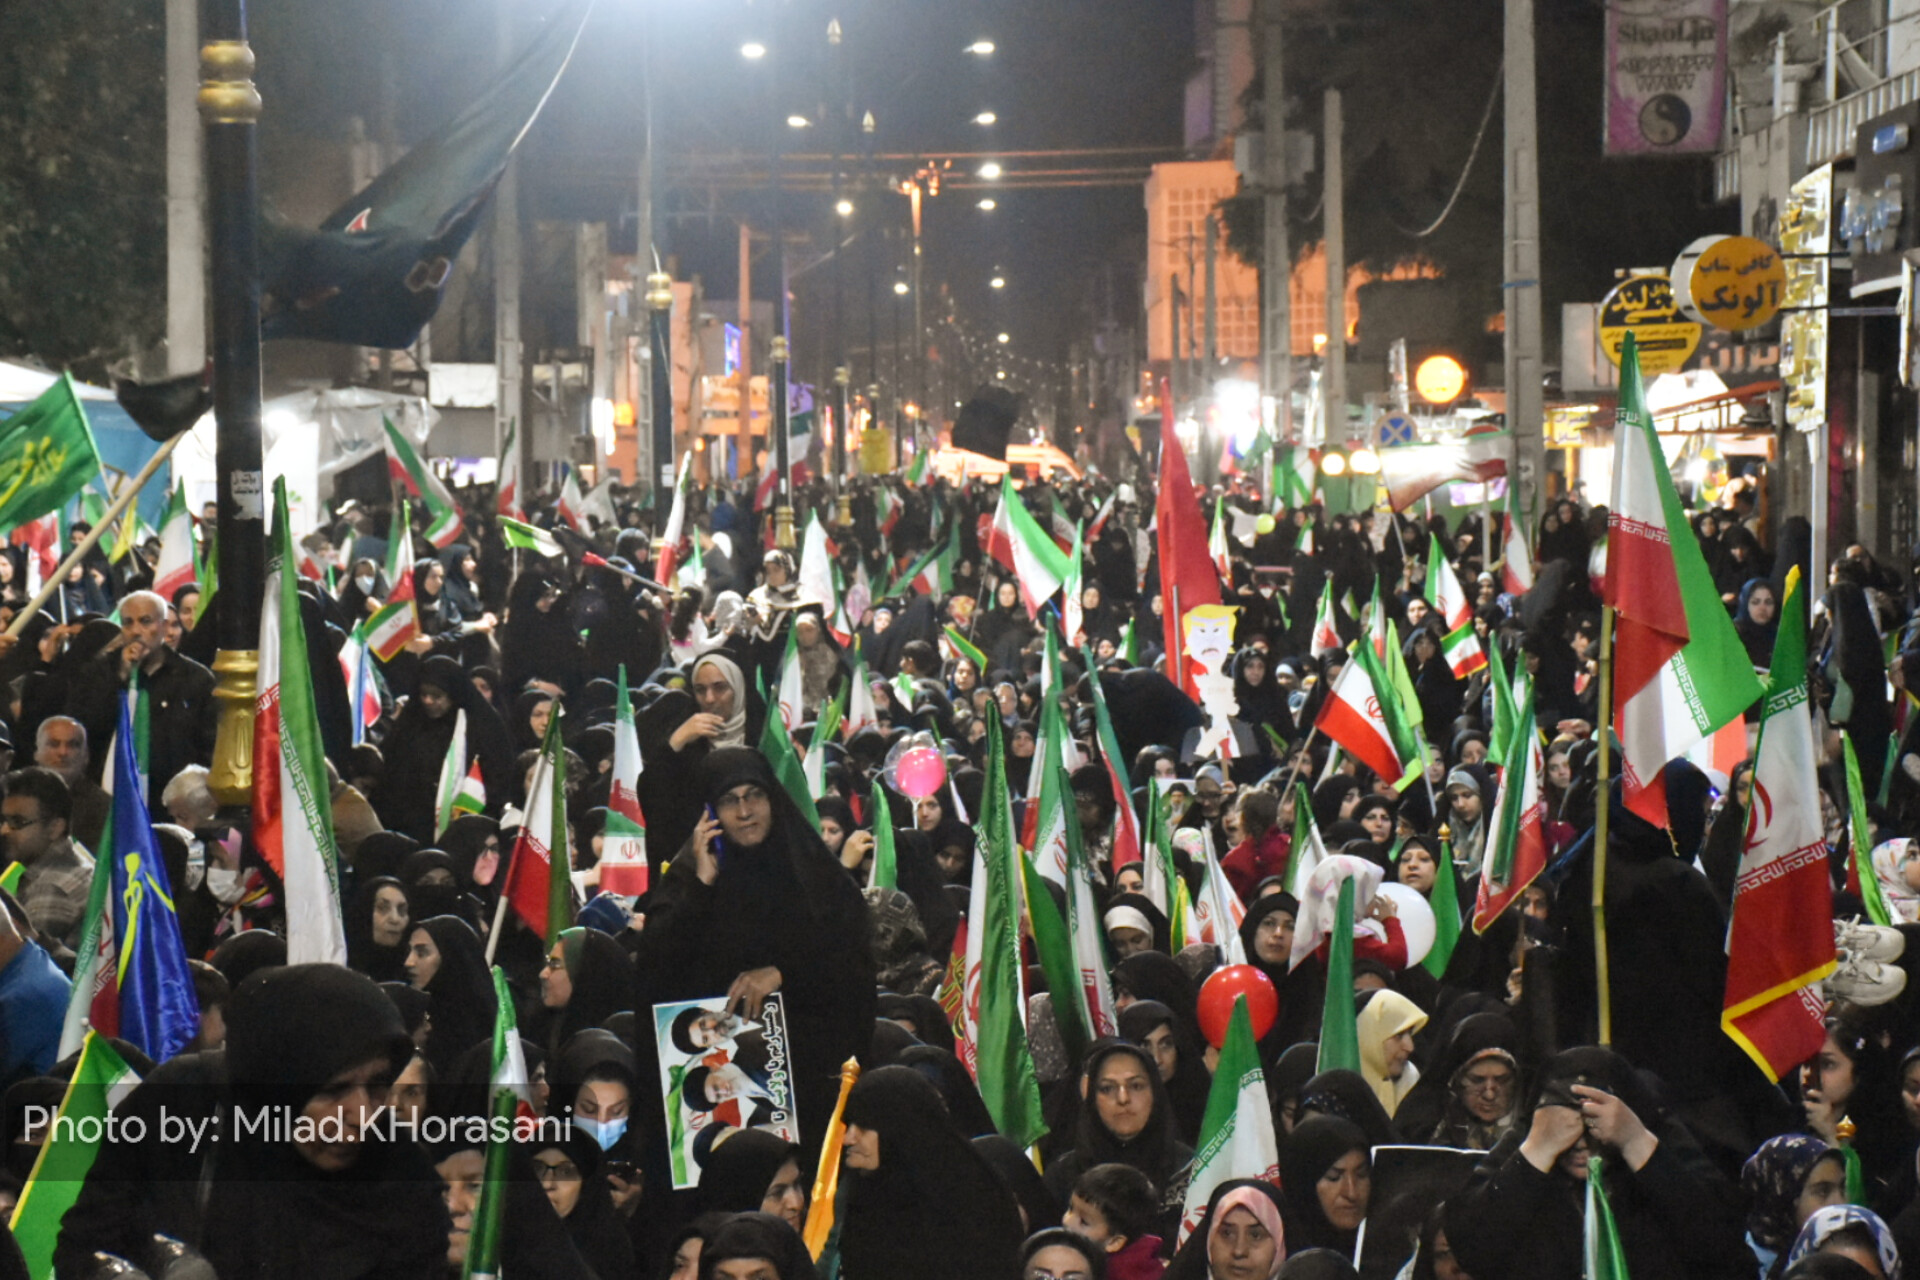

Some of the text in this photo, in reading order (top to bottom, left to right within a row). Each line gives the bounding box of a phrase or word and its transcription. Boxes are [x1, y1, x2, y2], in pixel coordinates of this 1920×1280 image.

[1736, 254, 1775, 276] کافی
[1699, 279, 1782, 319] آلونک
[767, 1070, 787, 1107] ولایت
